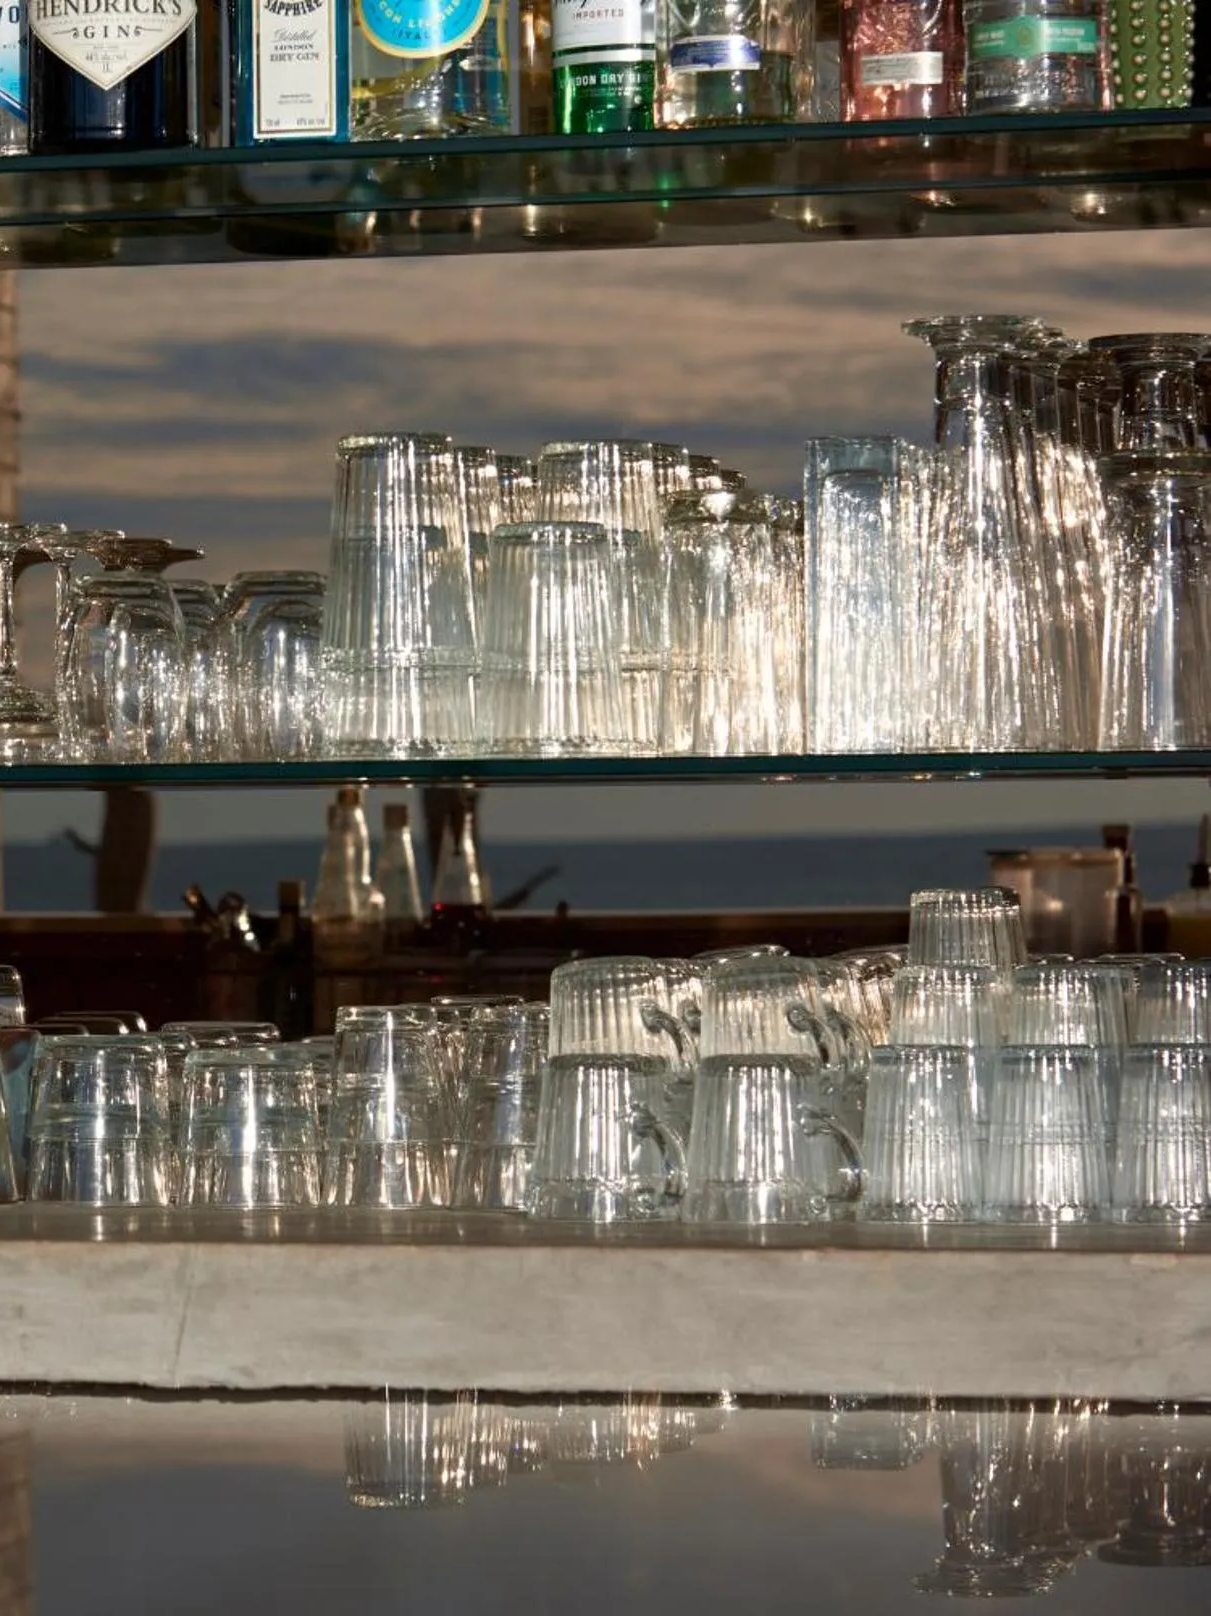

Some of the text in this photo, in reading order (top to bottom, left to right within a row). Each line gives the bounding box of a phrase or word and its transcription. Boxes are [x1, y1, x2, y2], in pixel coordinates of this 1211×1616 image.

[36, 0, 182, 20] HENDRICK'S
[264, 0, 323, 16] SAPPHIRE
[572, 8, 625, 20] IMPORTED
[83, 25, 130, 39] GIN
